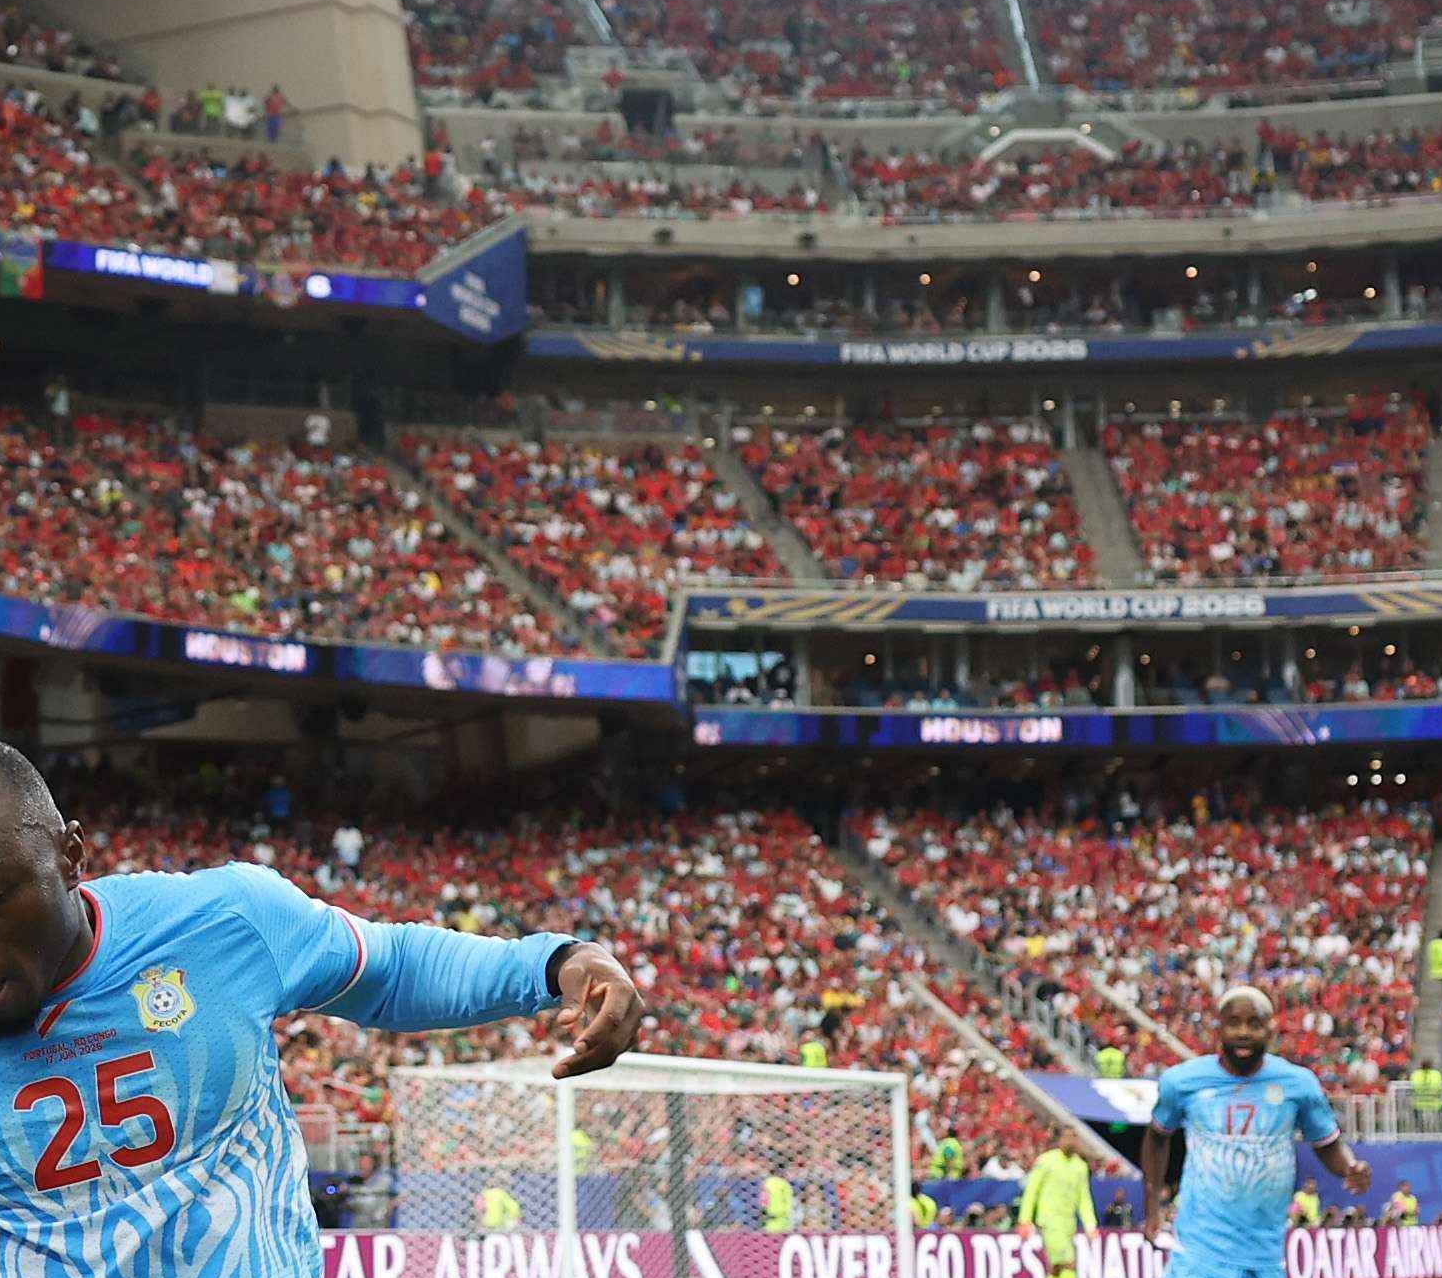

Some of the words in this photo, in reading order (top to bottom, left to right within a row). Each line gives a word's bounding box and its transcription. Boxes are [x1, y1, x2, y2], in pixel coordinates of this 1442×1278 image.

[840, 342, 887, 364] FIFA
[888, 342, 966, 365] WORLD
[968, 341, 1012, 364] CUP
[987, 597, 1038, 621] FIFA
[1040, 596, 1129, 621] WORLD
[1130, 596, 1180, 619] CUP
[921, 716, 1062, 743] HOUSTON
[12, 1049, 178, 1193] 25
[1226, 1104, 1258, 1136] 17
